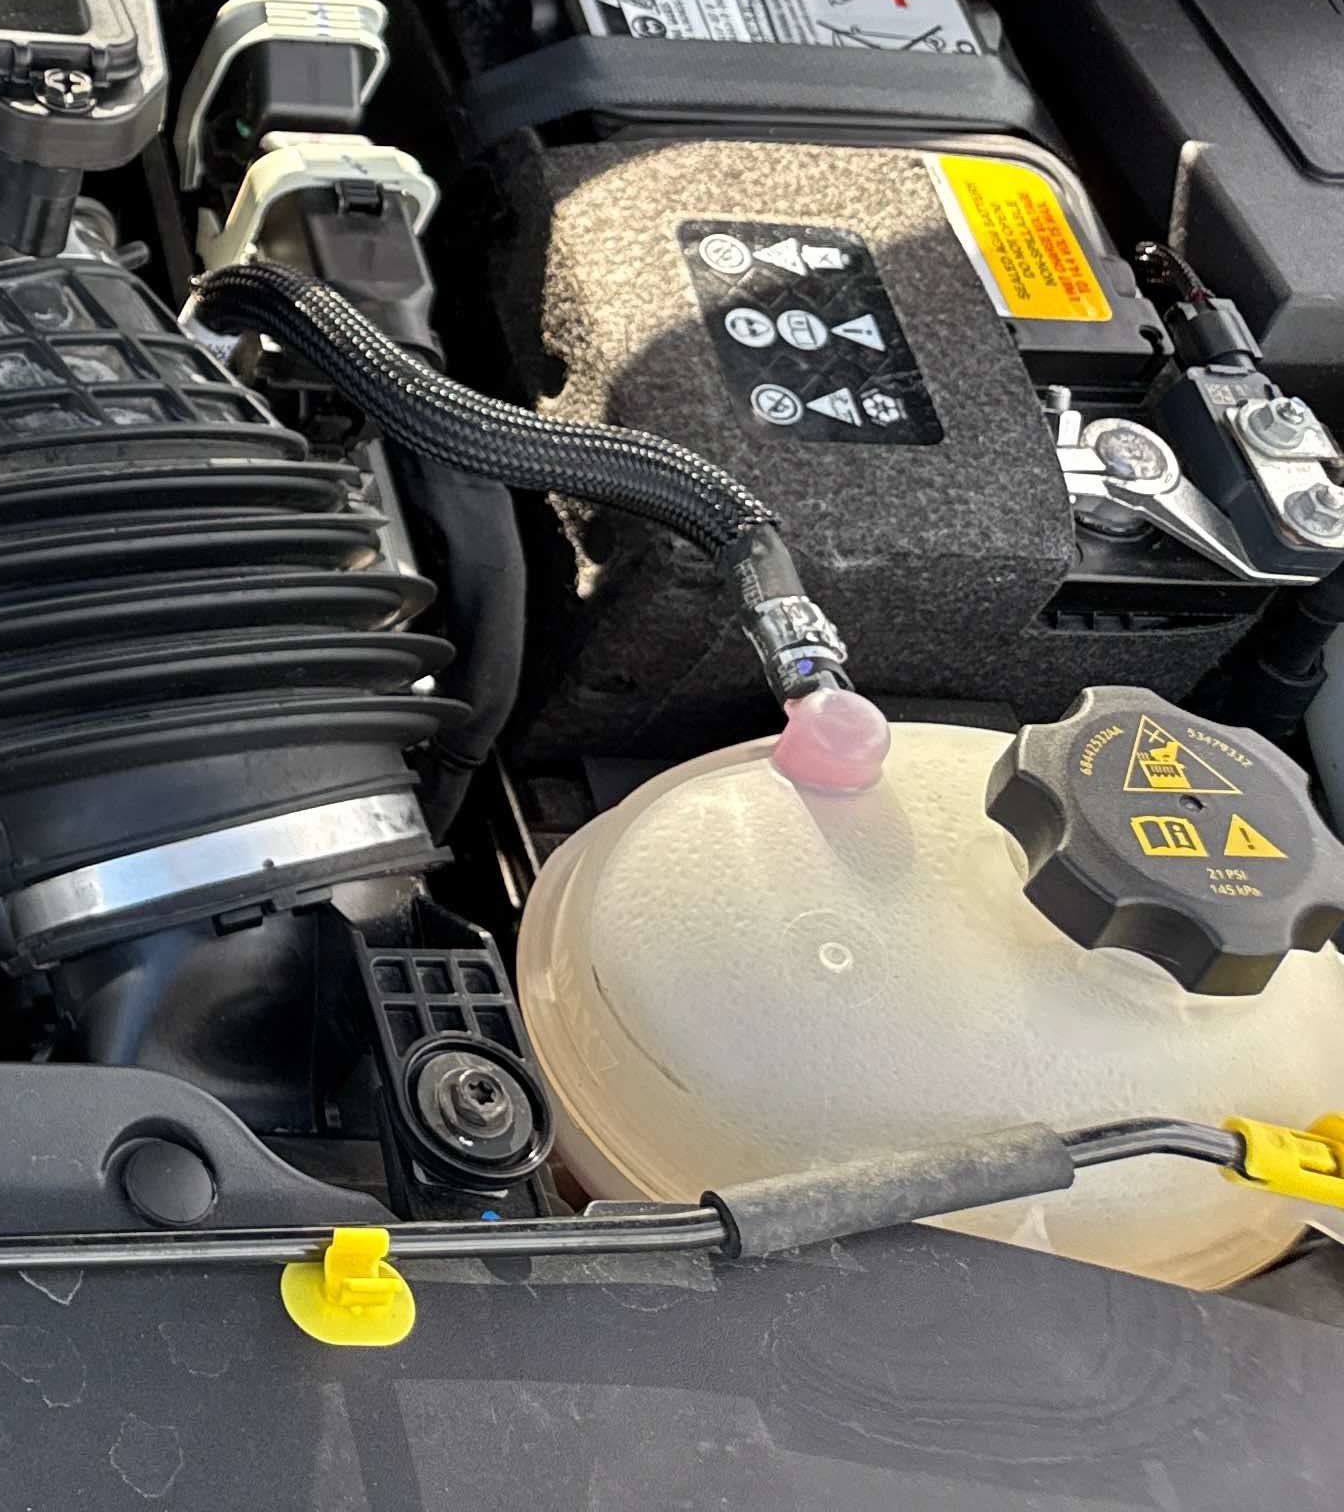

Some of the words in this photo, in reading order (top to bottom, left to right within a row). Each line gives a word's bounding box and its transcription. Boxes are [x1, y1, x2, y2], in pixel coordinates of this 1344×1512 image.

[1206, 867, 1225, 880] 21
[1225, 868, 1248, 881] PSI
[1210, 884, 1236, 896] 145
